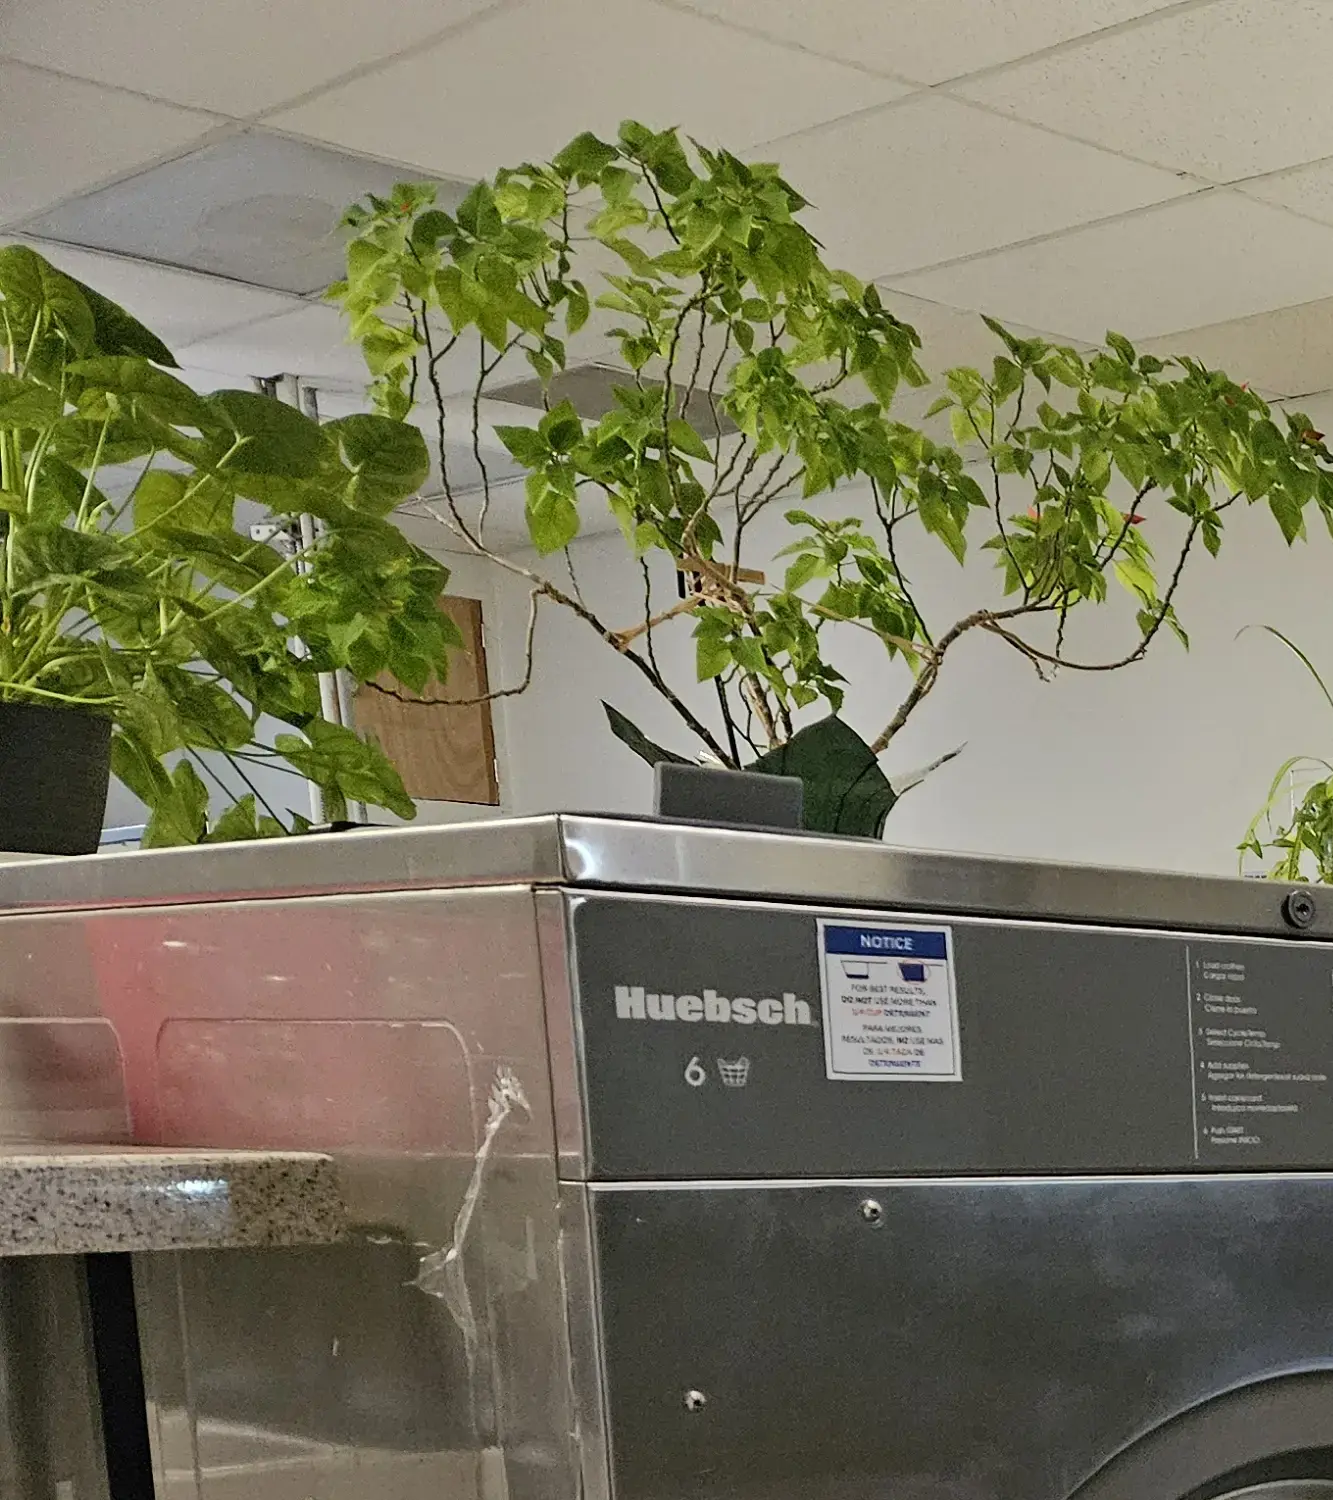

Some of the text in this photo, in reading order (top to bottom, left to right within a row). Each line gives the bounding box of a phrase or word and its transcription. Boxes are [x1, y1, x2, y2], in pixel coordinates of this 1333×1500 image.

[860, 934, 915, 950] NOTICE
[614, 985, 812, 1025] Huebsch
[684, 1056, 706, 1087] 6
